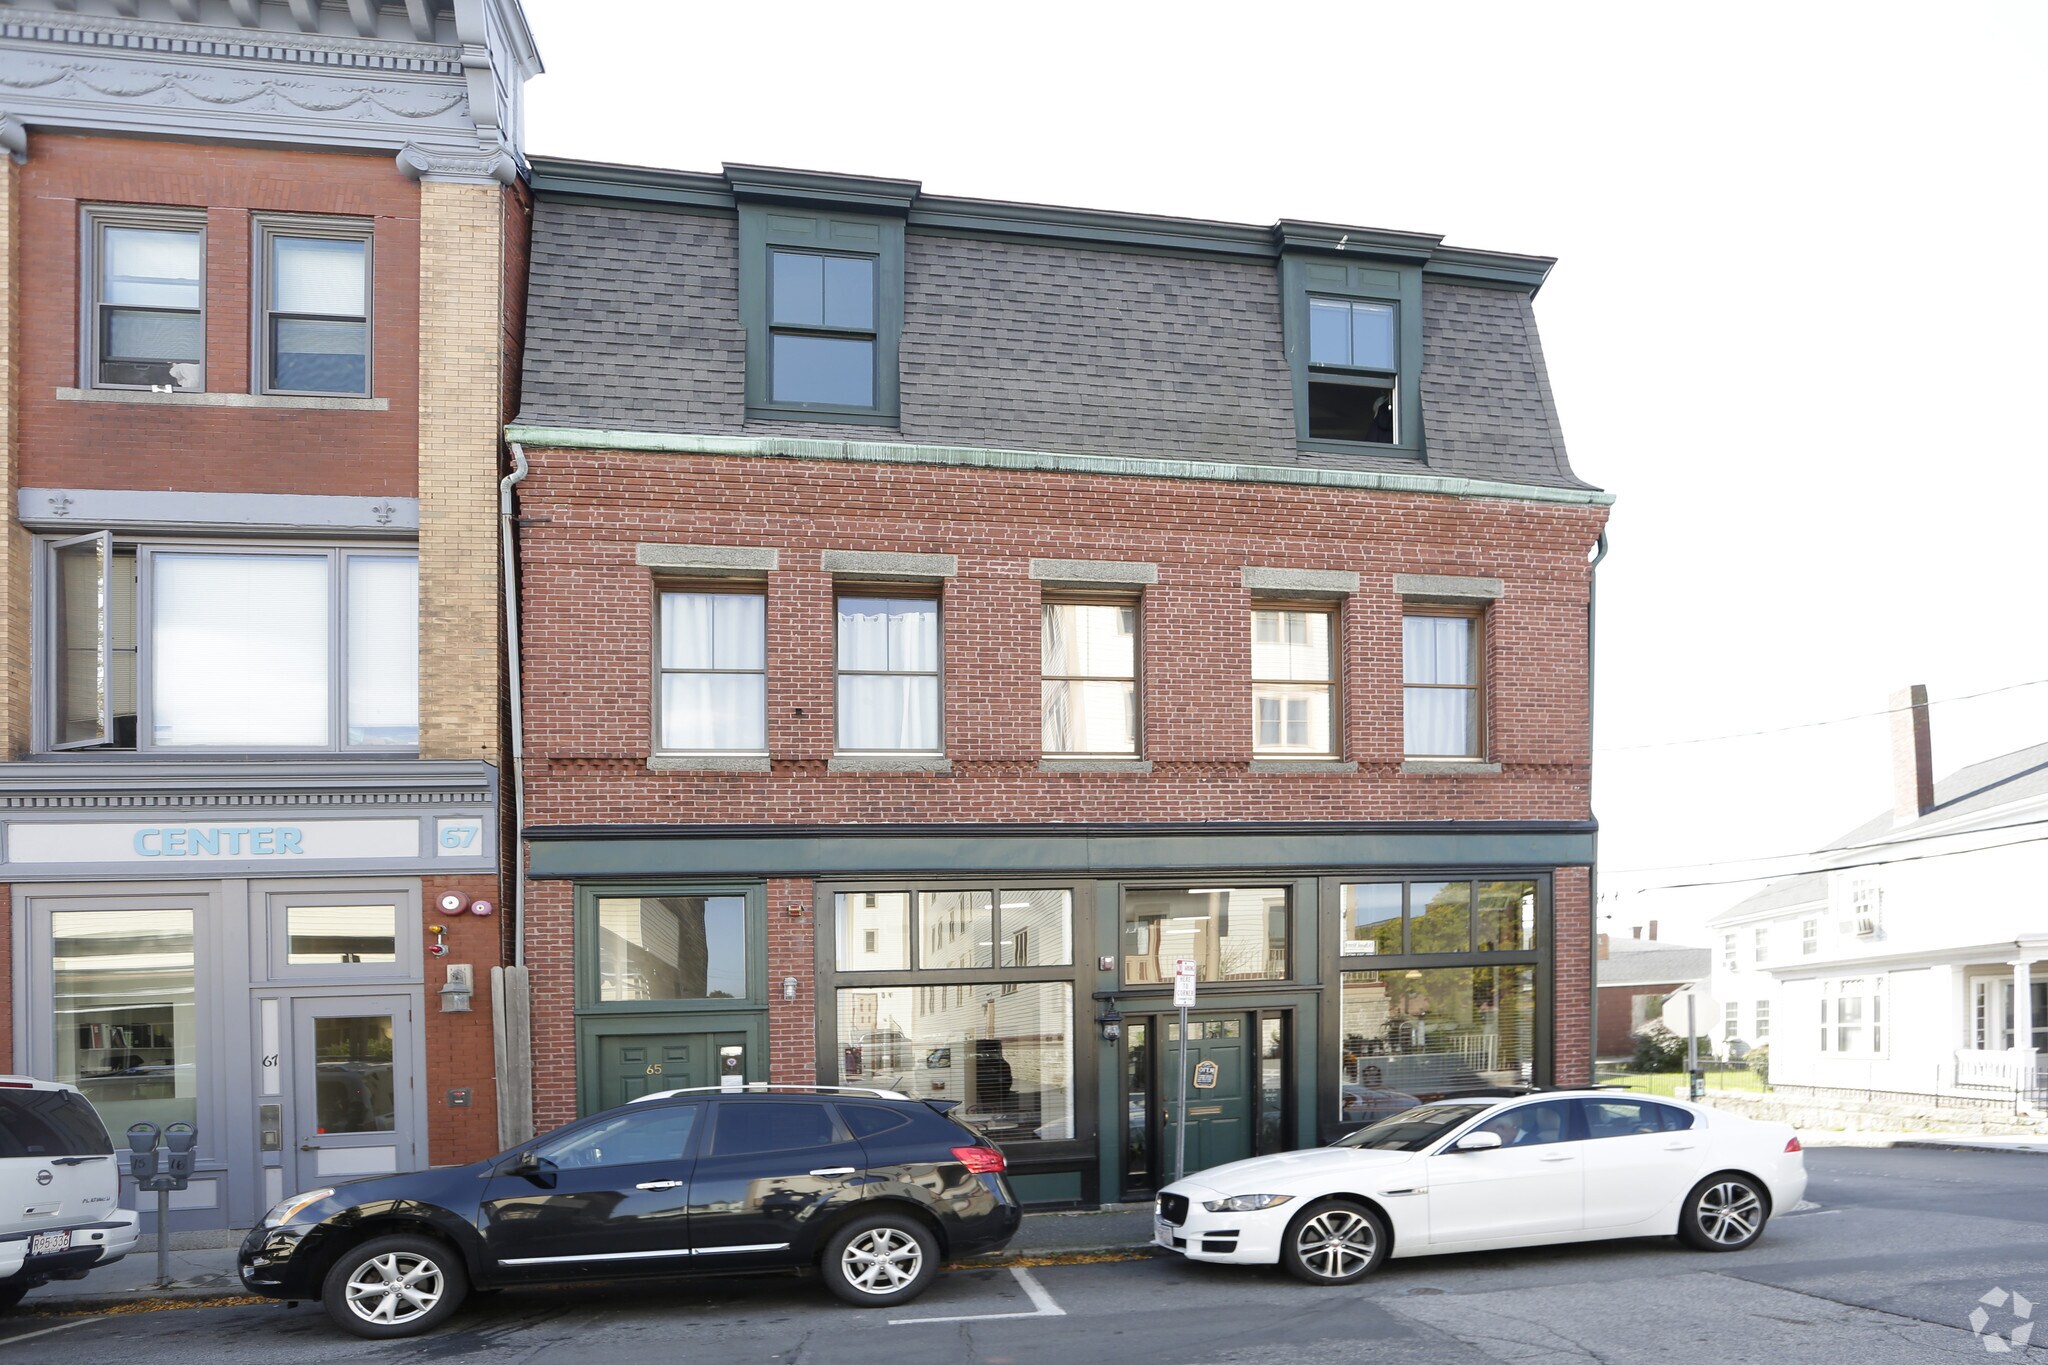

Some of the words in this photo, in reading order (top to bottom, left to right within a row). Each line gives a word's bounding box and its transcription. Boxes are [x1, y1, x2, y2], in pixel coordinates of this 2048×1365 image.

[133, 826, 304, 856] CENTER
[440, 825, 479, 849] 67
[646, 1063, 662, 1075] 65
